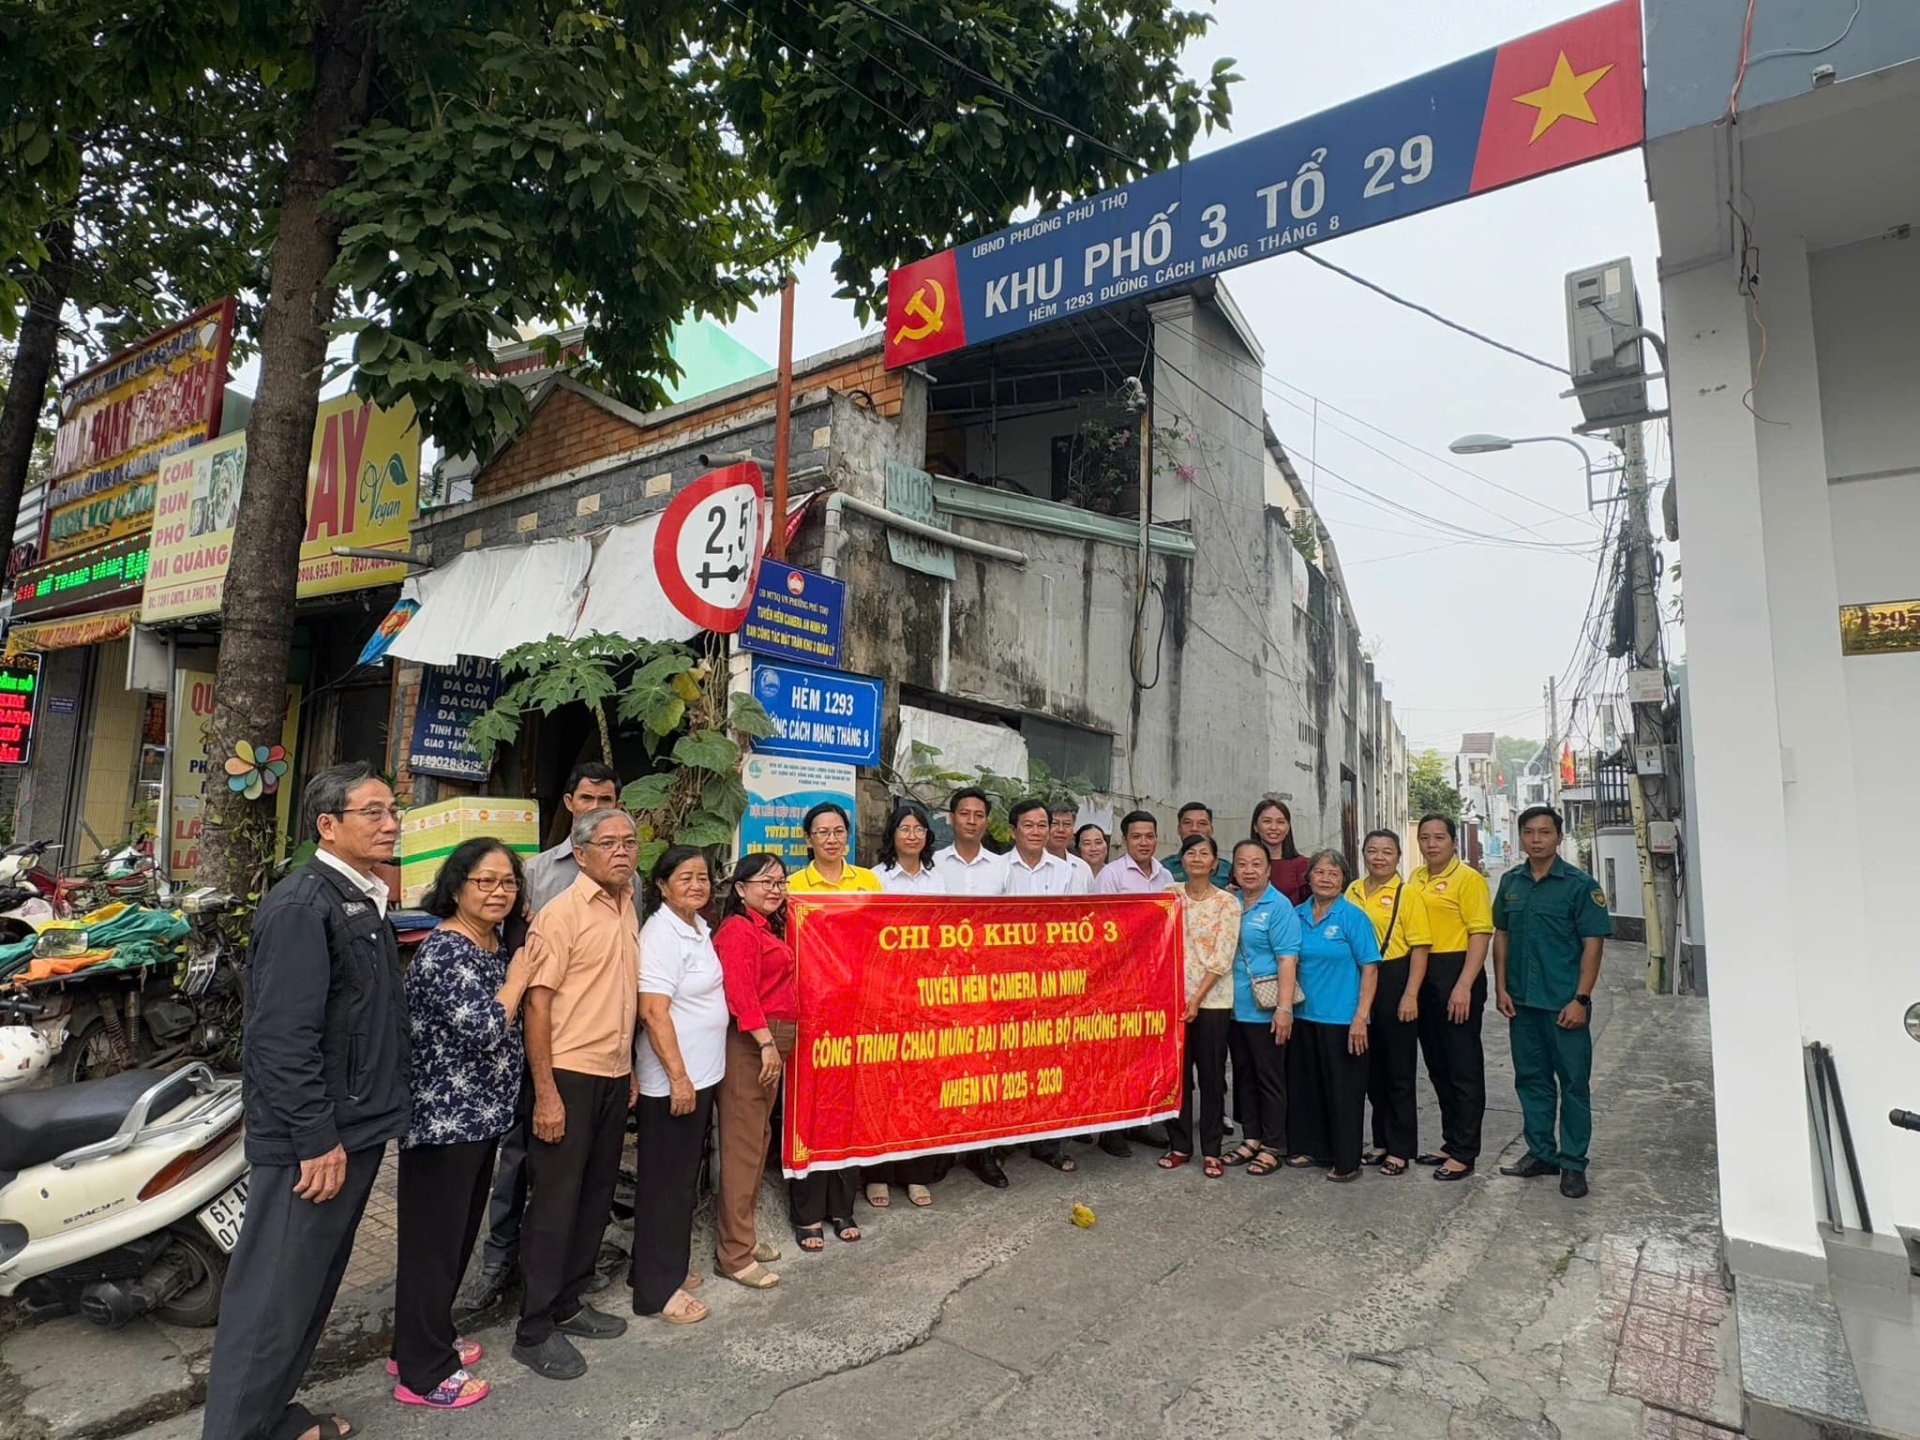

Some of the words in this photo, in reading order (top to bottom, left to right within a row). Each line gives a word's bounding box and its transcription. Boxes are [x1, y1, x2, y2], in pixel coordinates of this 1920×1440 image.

[972, 236, 1005, 258] UBND
[1010, 216, 1062, 246] PHƯỜNG
[1066, 201, 1095, 225] PHÚ
[1099, 191, 1129, 213] THỌ
[984, 256, 1063, 318] KHU
[1083, 201, 1181, 287] PHỐ
[1199, 203, 1228, 249] 3
[1256, 147, 1328, 230] TỔ
[1363, 134, 1434, 200] 29
[1064, 294, 1094, 311] 1293
[1100, 274, 1149, 301] ĐƯỜNG
[1155, 260, 1195, 284] CÁCH
[1201, 244, 1249, 270] MẠNG
[1257, 221, 1318, 252] THÁNG
[1329, 215, 1340, 232] 8
[304, 402, 373, 542] AY
[360, 458, 402, 528] Vegan
[0, 709, 31, 725] RANG
[791, 678, 820, 712] HẺM
[824, 692, 855, 716] 1293
[424, 738, 445, 749] GIAO
[770, 710, 788, 739] ỜNG
[788, 714, 811, 742] CÁCH
[812, 723, 834, 748] MẠNG
[837, 722, 861, 747] THÁNG
[863, 729, 869, 748] 8
[879, 925, 930, 950] CHI
[939, 918, 974, 952] BỘ
[983, 922, 1037, 947] KHU
[1046, 911, 1095, 944] PHỐ
[1103, 920, 1119, 943] 3
[917, 963, 959, 1007] TUYẾN
[961, 964, 988, 1004] HẺM
[990, 971, 1037, 1002] CAMERA
[1041, 970, 1057, 998] AN
[1059, 969, 1087, 996] NINH
[812, 1029, 852, 1070] CÔNG
[856, 1025, 899, 1064] TRÌNH
[900, 1022, 936, 1062] CHÀO
[938, 1019, 975, 1058] MỪNG
[976, 1023, 997, 1060] ĐẠI
[1000, 1015, 1019, 1058] HỘI
[1022, 1010, 1053, 1049] ĐẢNG
[1056, 1011, 1071, 1052] BỘ
[1073, 1008, 1118, 1043] PHƯỜNG
[1120, 1004, 1143, 1038] PHÚ
[1145, 1009, 1167, 1043] THỌ
[940, 1070, 980, 1115] NHIỆM
[1001, 1070, 1028, 1101] 2025
[1037, 1066, 1063, 1097] 2030
[218, 1211, 245, 1247] 07
